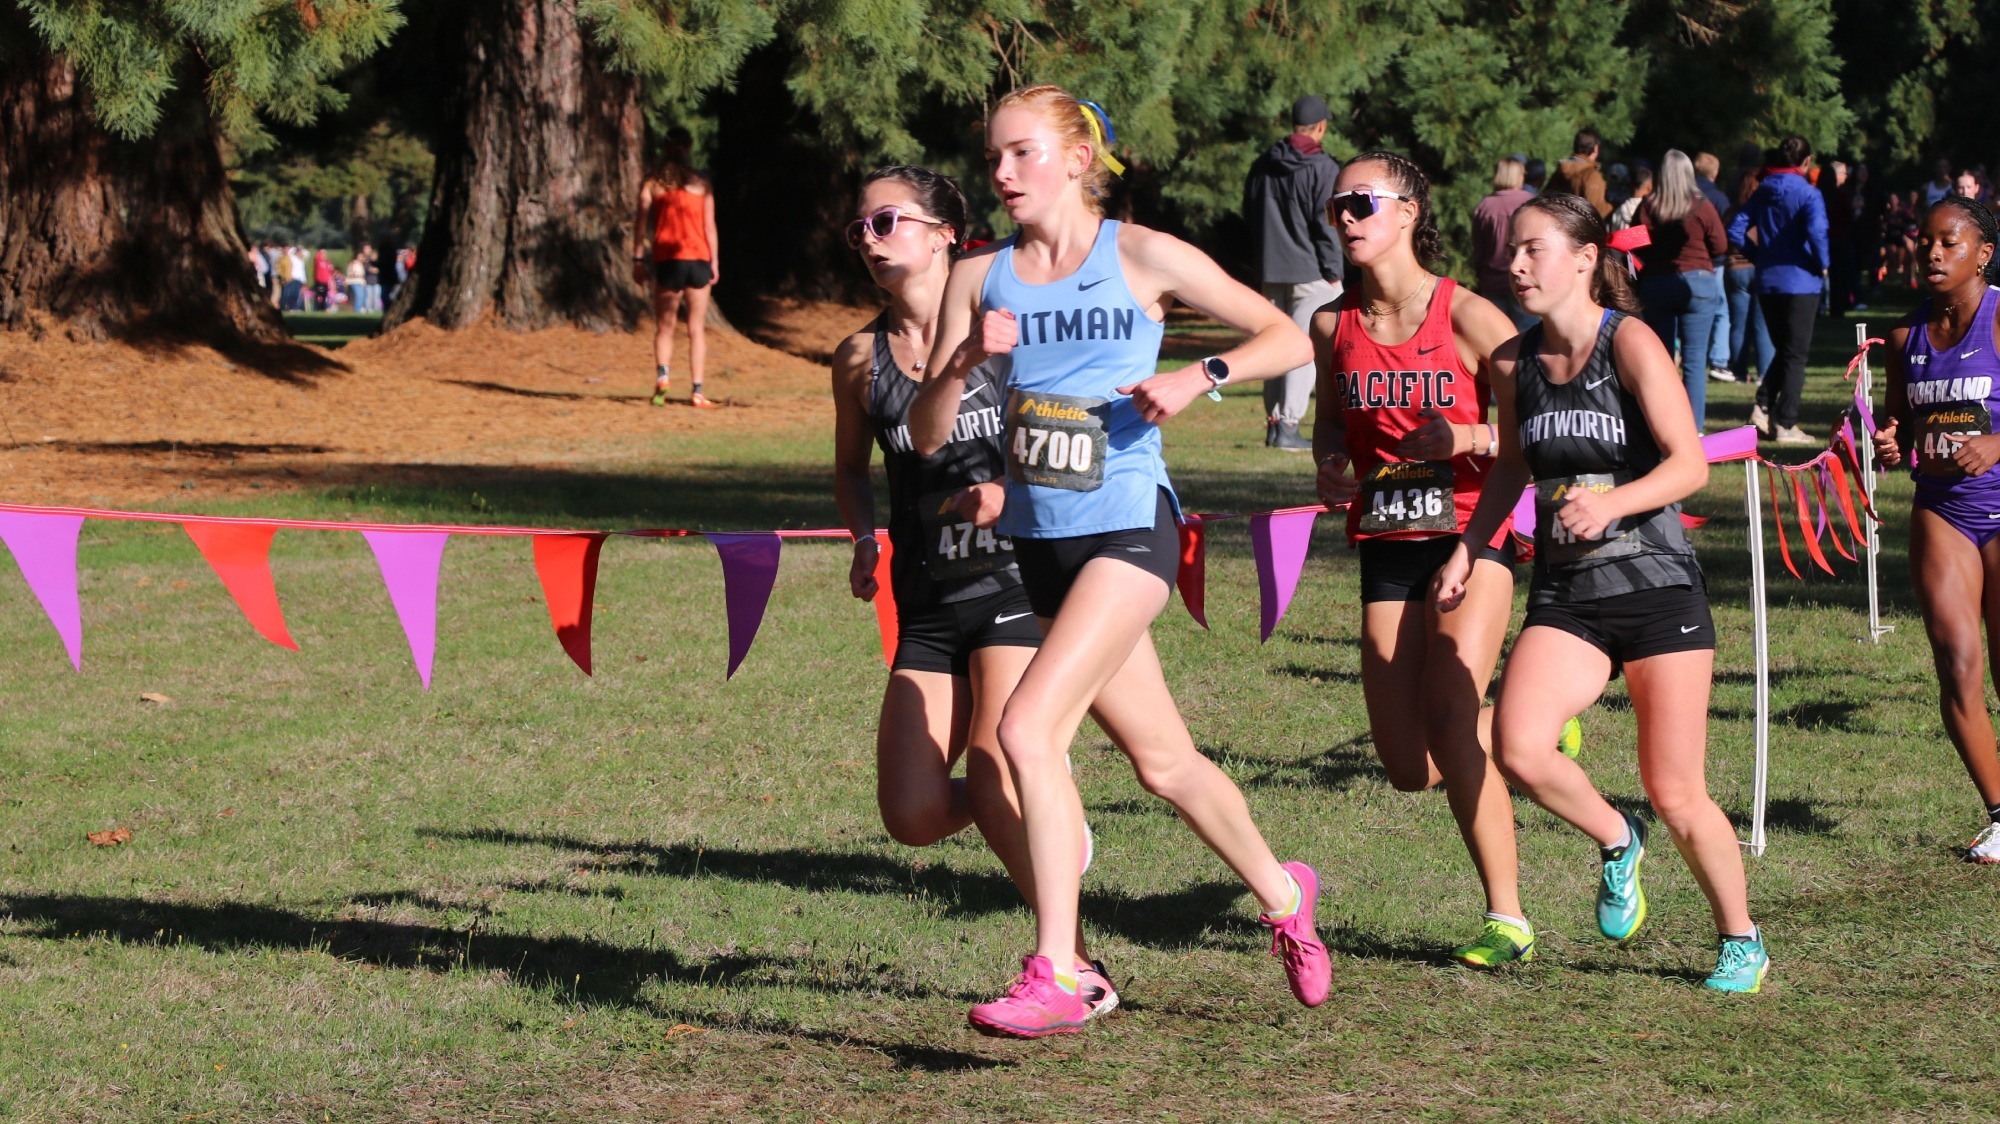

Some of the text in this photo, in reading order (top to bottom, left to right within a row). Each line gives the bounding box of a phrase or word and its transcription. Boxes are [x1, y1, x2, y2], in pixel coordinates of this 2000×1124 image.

[1013, 306, 1135, 348] ITMAN
[1335, 370, 1456, 410] PACIFIC
[1906, 376, 1993, 408] PORTLAND
[1012, 426, 1093, 472] 4700
[1371, 487, 1443, 521] 4436
[1551, 512, 1626, 545] 42
